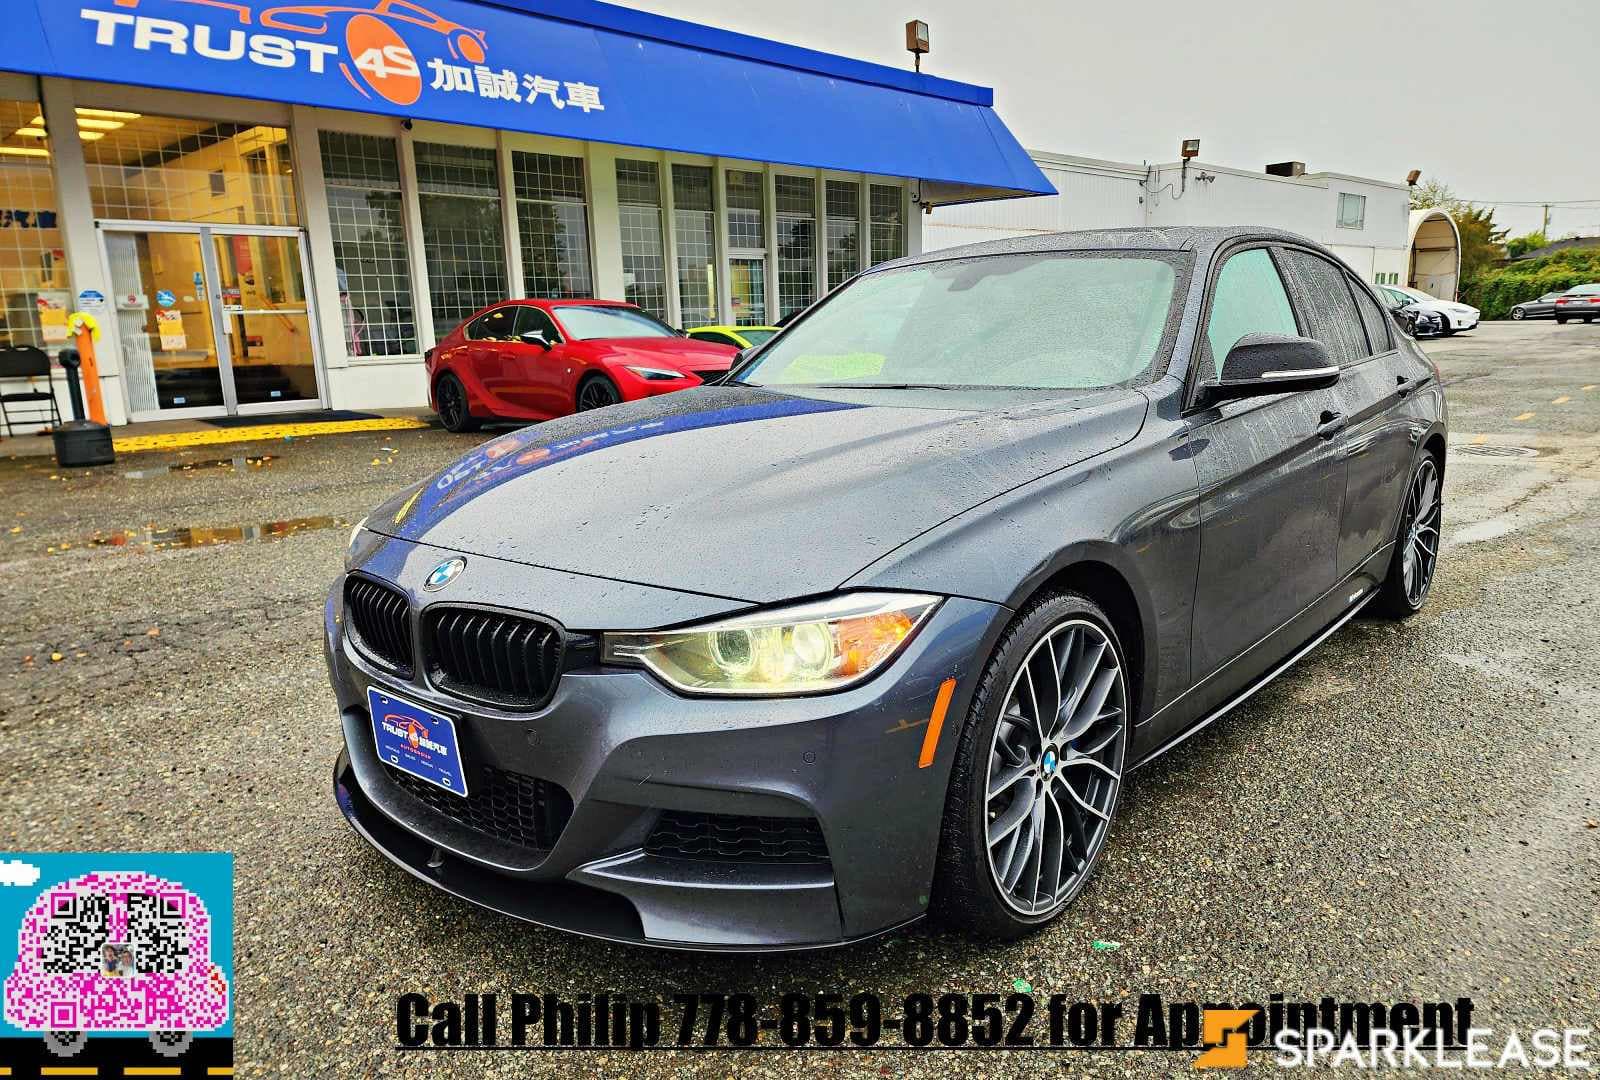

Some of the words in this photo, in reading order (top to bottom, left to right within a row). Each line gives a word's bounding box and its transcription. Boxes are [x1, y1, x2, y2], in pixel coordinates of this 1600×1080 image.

[81, 9, 339, 73] TRUST
[354, 45, 420, 78] 4S
[427, 58, 605, 113] 加誠汽車
[381, 721, 409, 740] TRUST
